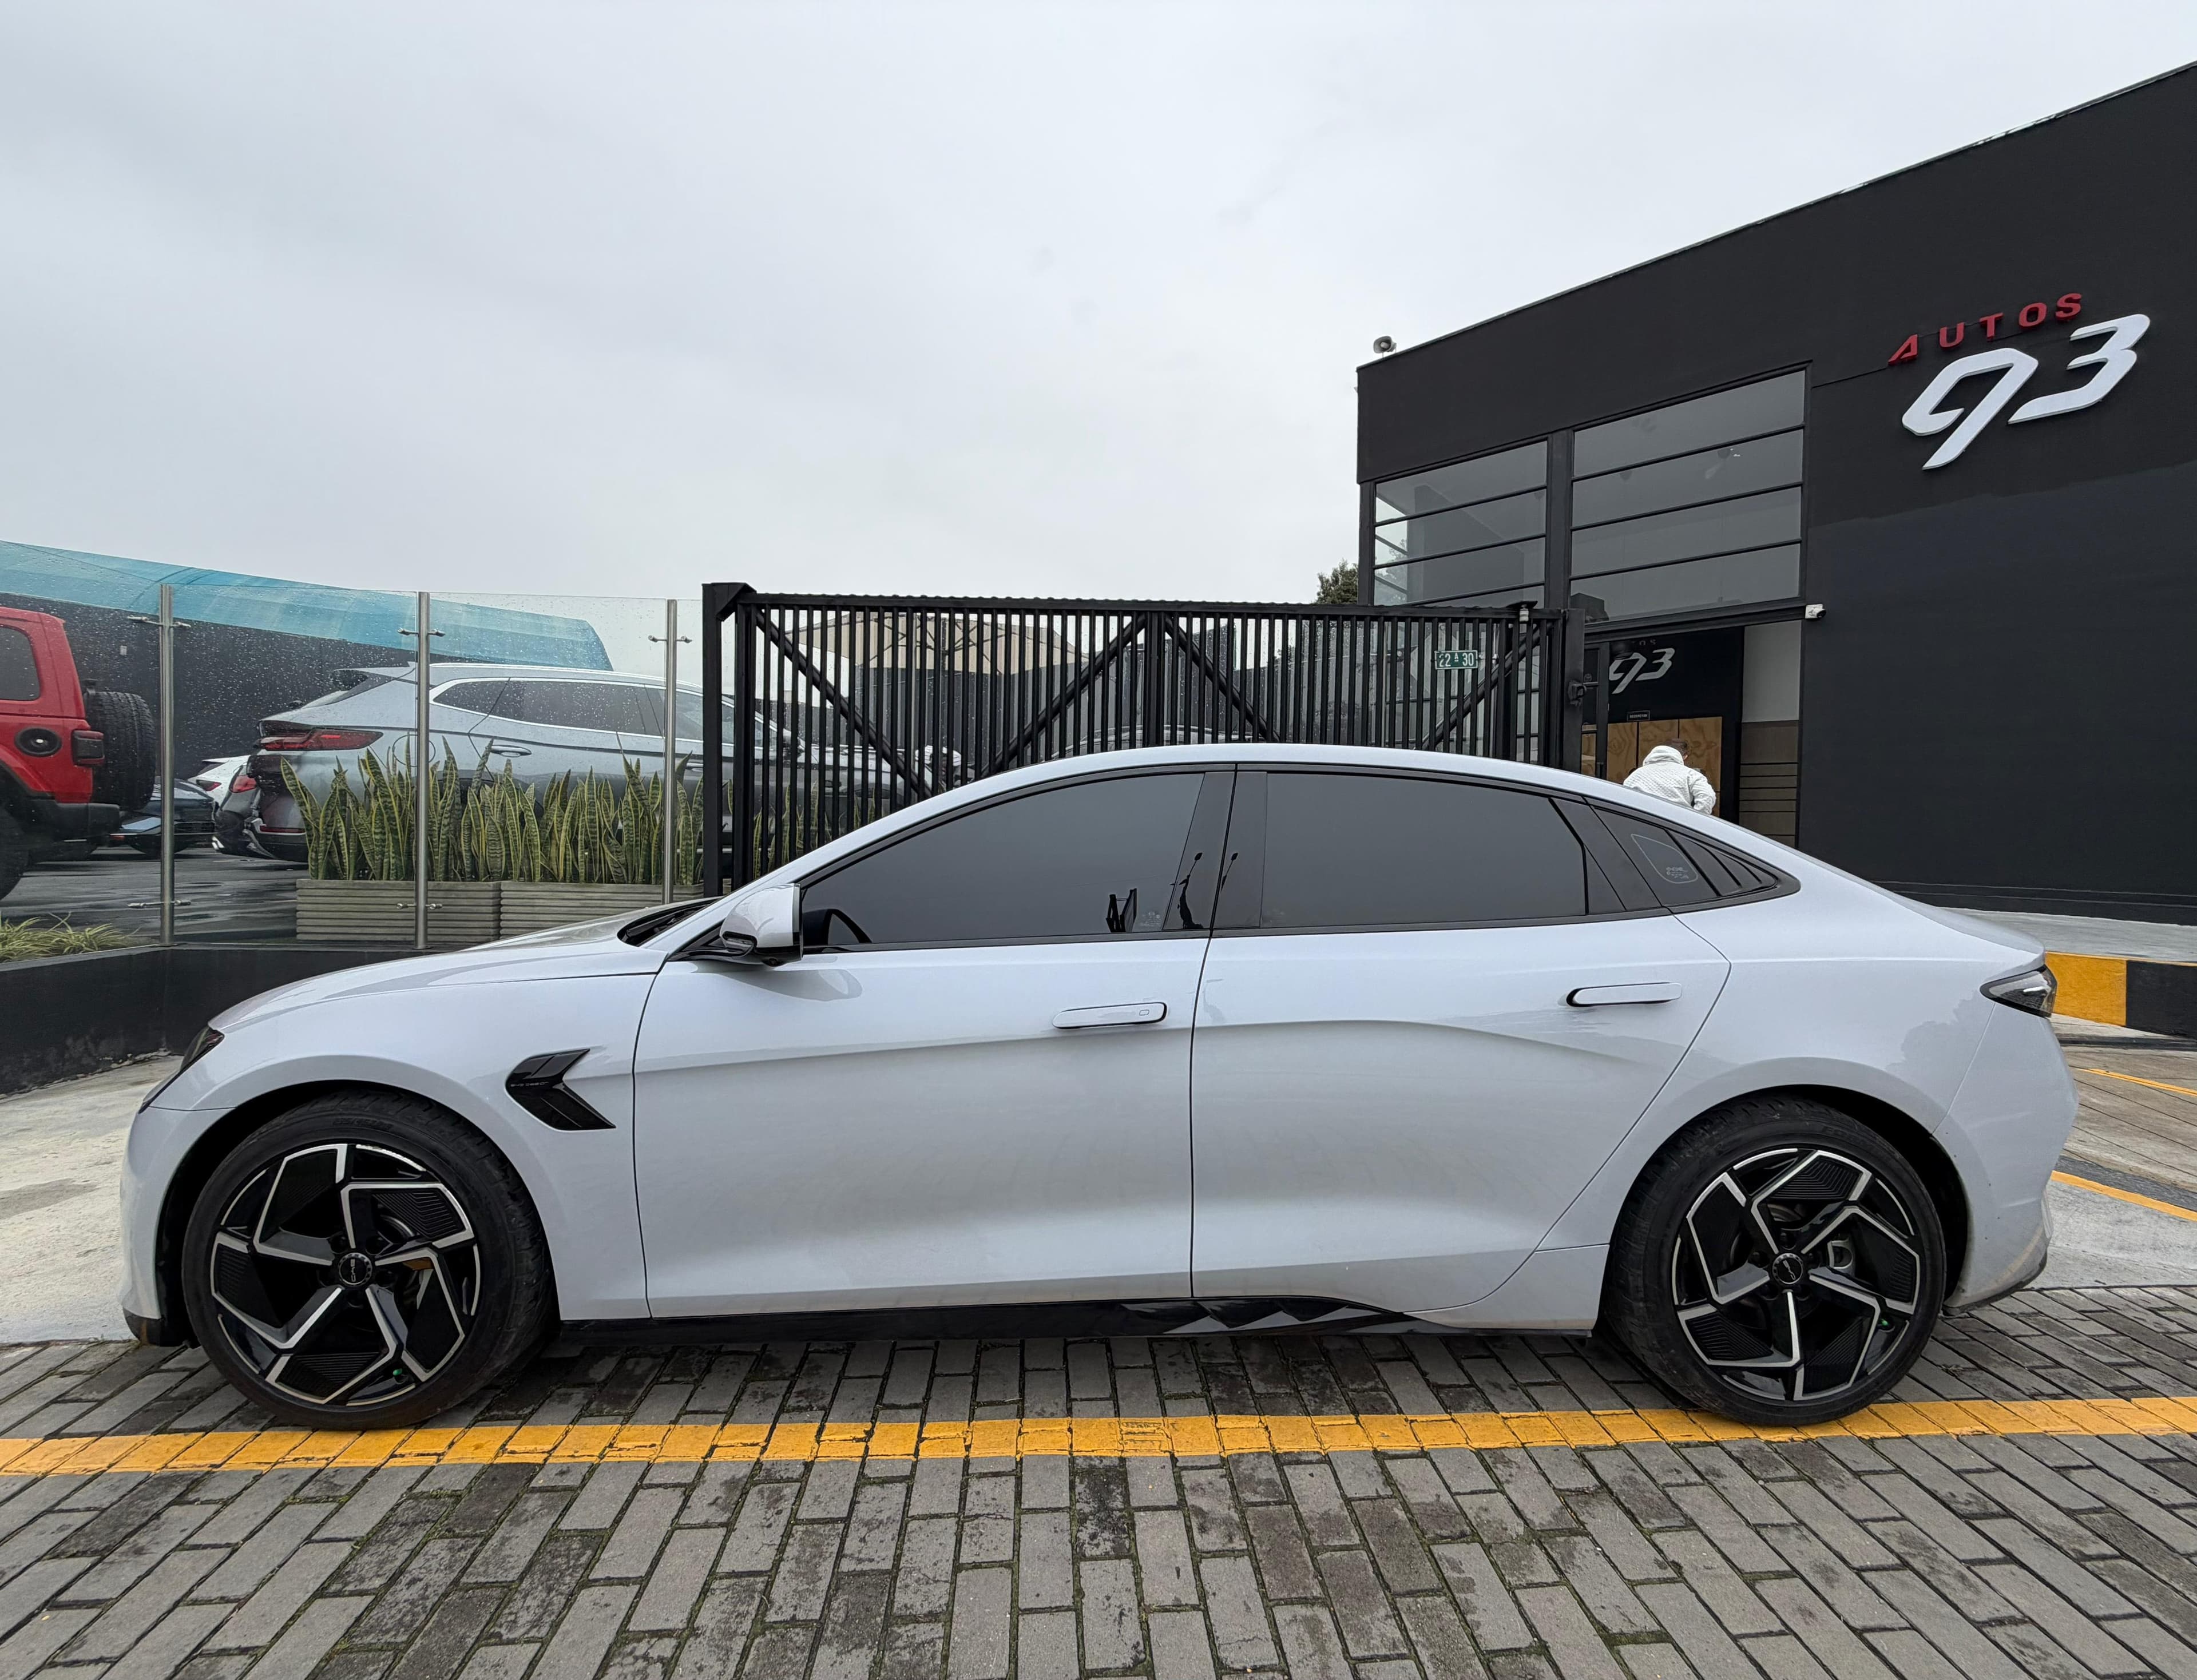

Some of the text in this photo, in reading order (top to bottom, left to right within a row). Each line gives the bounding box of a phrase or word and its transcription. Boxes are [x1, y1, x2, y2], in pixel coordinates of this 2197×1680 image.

[1887, 292, 2083, 366] AUTOS
[1902, 313, 2151, 470] 93
[1438, 653, 1452, 668] 22
[1462, 652, 1474, 666] 30
[1608, 647, 1676, 694] 93
